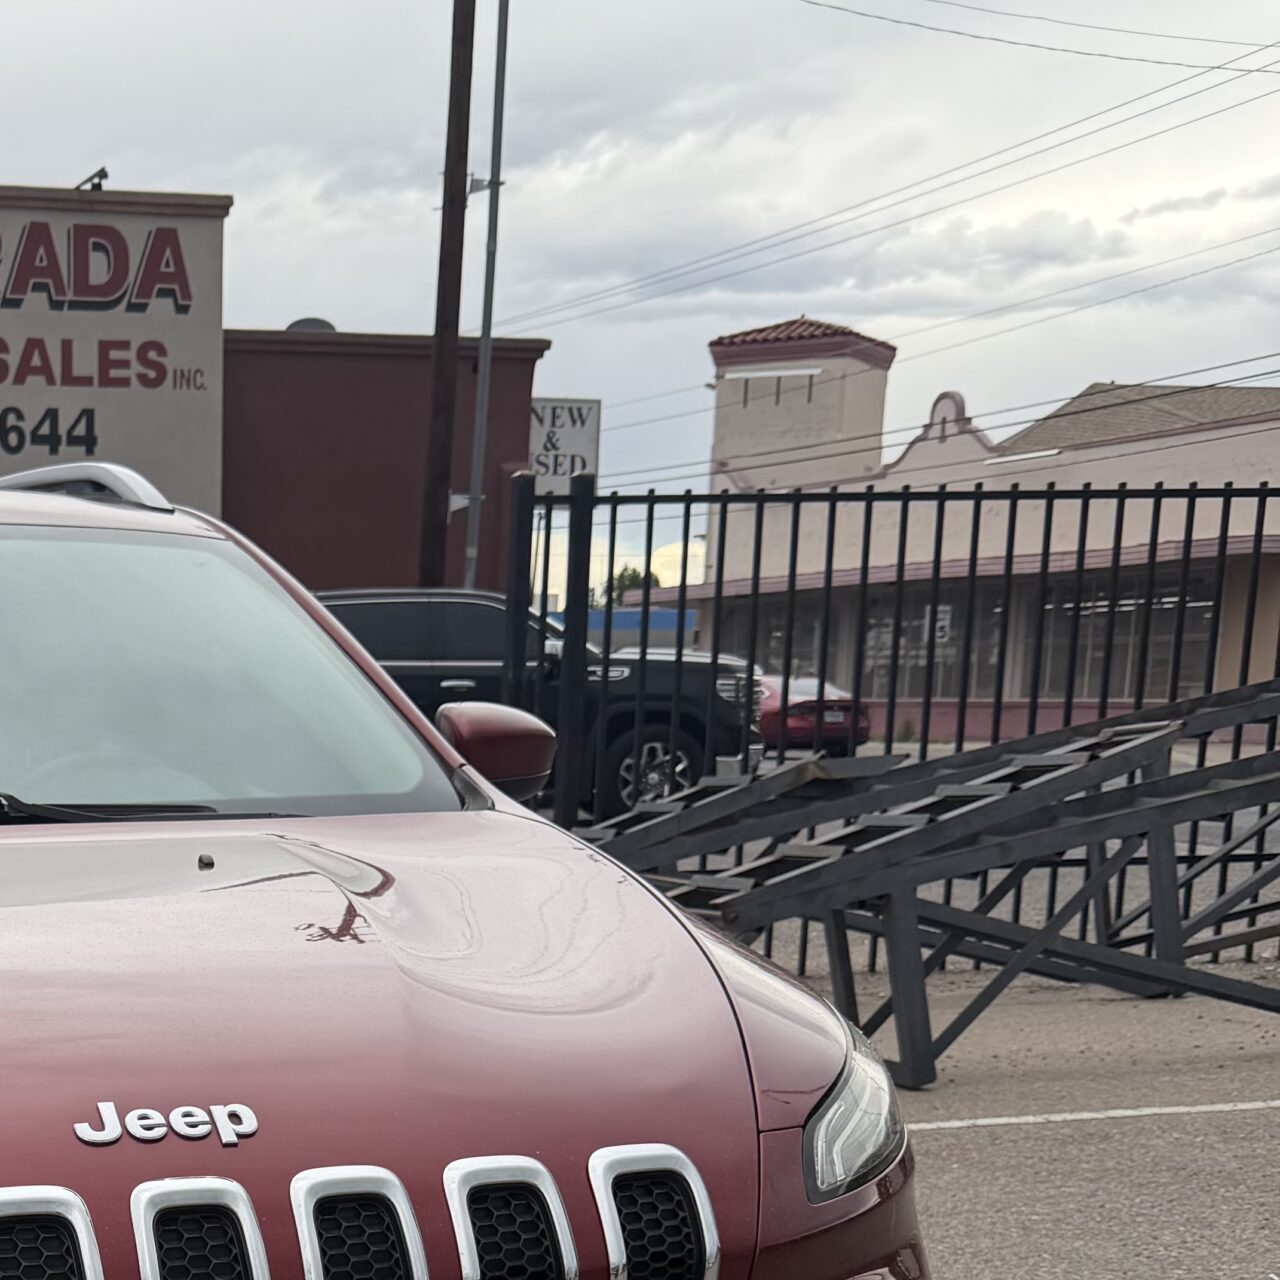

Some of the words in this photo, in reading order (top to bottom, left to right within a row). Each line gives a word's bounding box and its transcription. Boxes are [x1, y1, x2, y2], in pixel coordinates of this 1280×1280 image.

[172, 367, 207, 391] INC.
[530, 405, 593, 428] NEW
[543, 430, 560, 452] &
[530, 452, 586, 477] SED
[73, 1101, 259, 1148] Jeep
